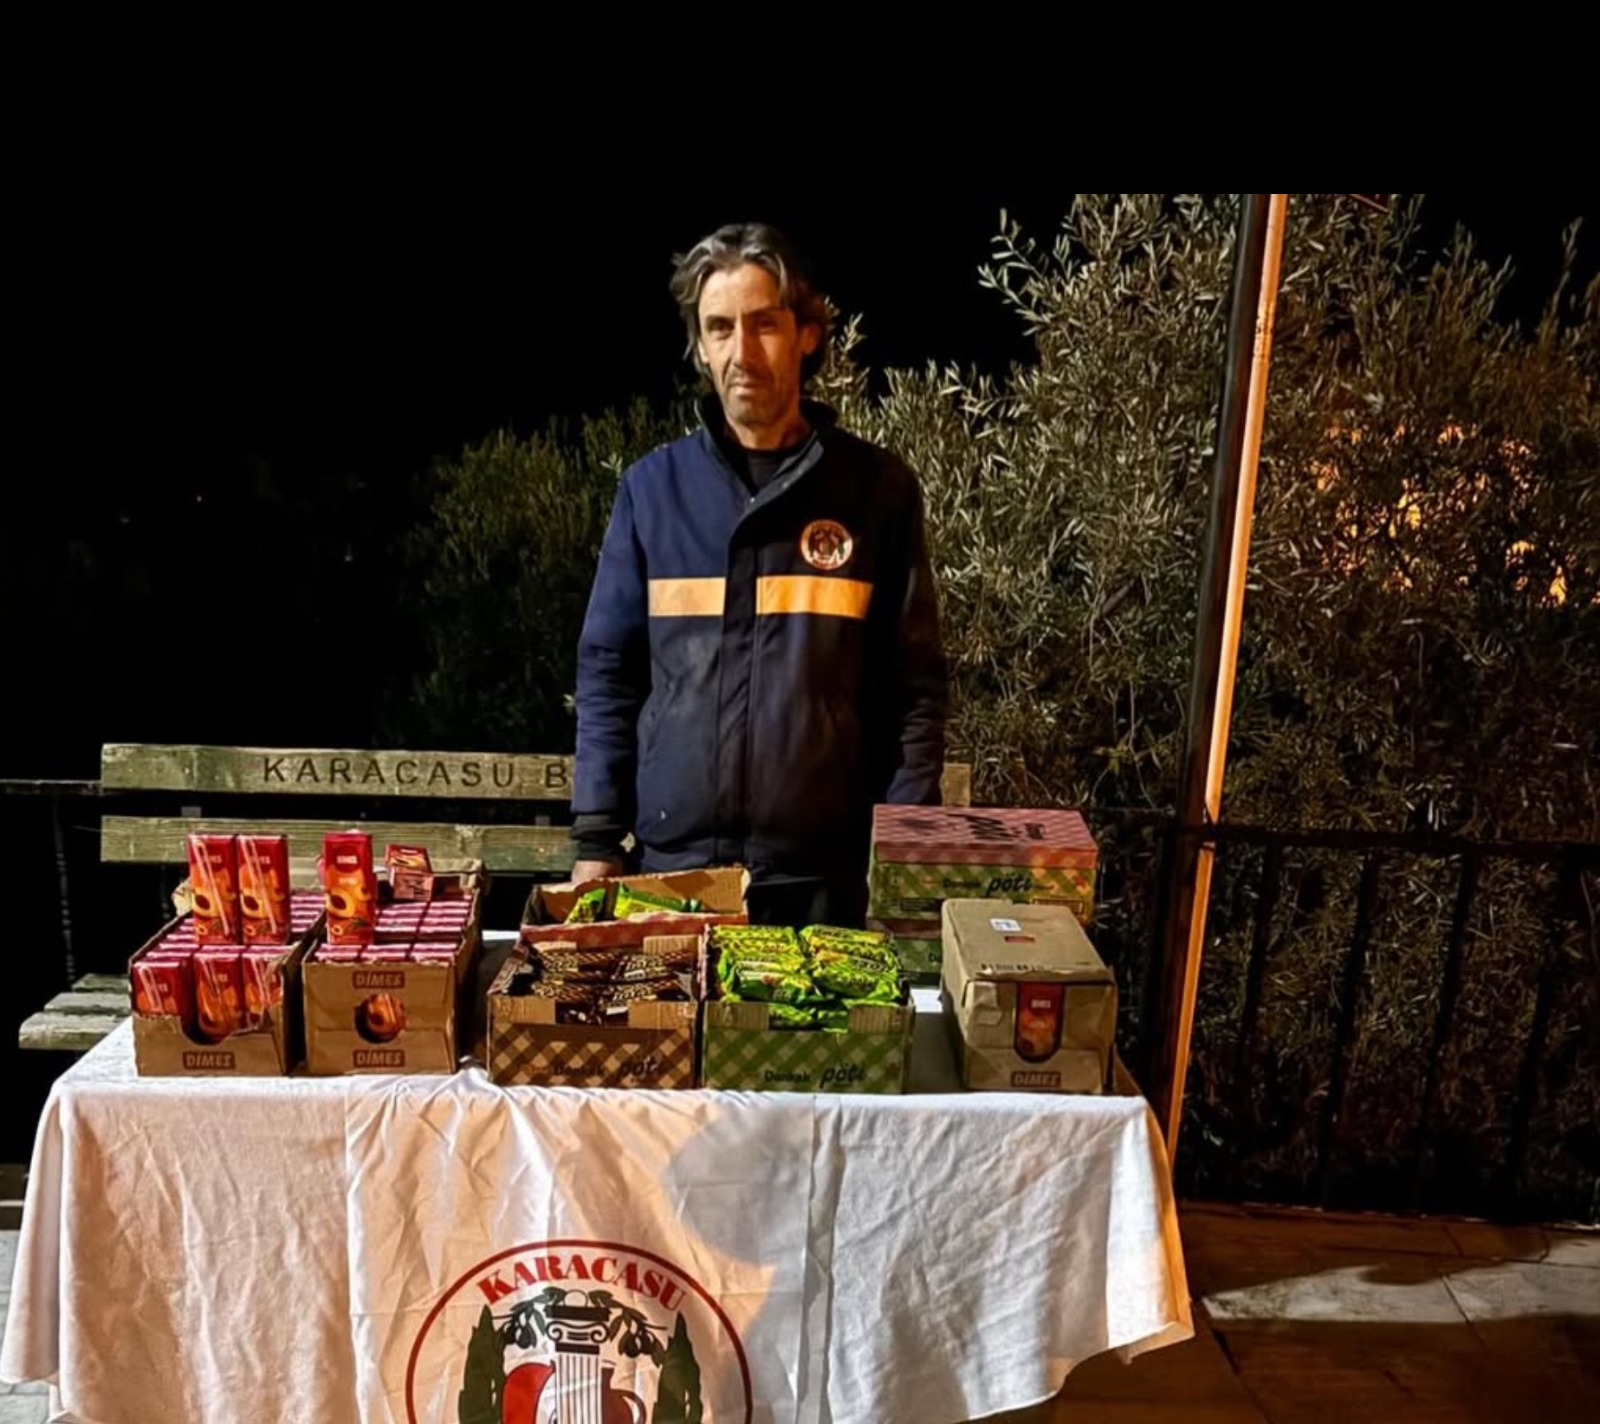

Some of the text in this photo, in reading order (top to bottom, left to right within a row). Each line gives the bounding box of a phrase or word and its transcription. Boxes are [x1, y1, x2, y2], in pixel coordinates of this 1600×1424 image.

[262, 757, 515, 787] KARACASU
[818, 1062, 866, 1089] pöti
[476, 1253, 687, 1312] KARACASU
